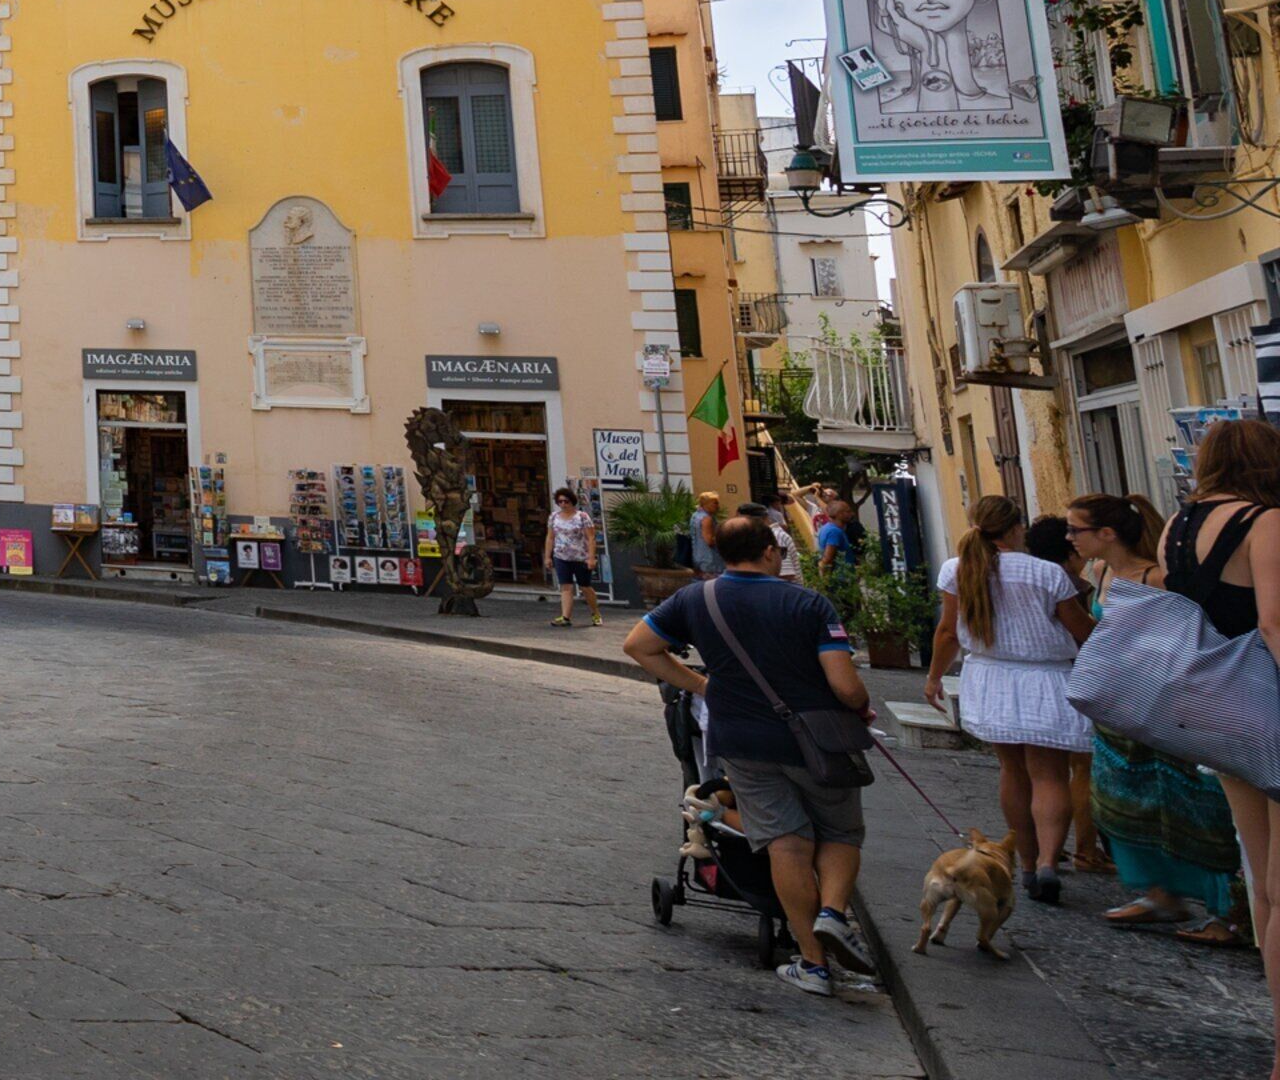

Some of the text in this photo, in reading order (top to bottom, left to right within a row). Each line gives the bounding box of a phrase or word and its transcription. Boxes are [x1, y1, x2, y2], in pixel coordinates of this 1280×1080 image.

[899, 116, 959, 132] gioiello
[963, 114, 982, 126] di
[986, 113, 1030, 126] Ischia
[86, 352, 192, 366] IMAGÆNARIA
[431, 359, 553, 374] IMAGÆNARIA
[598, 431, 640, 445] Museo
[618, 448, 638, 461] del
[604, 463, 640, 477] Mare
